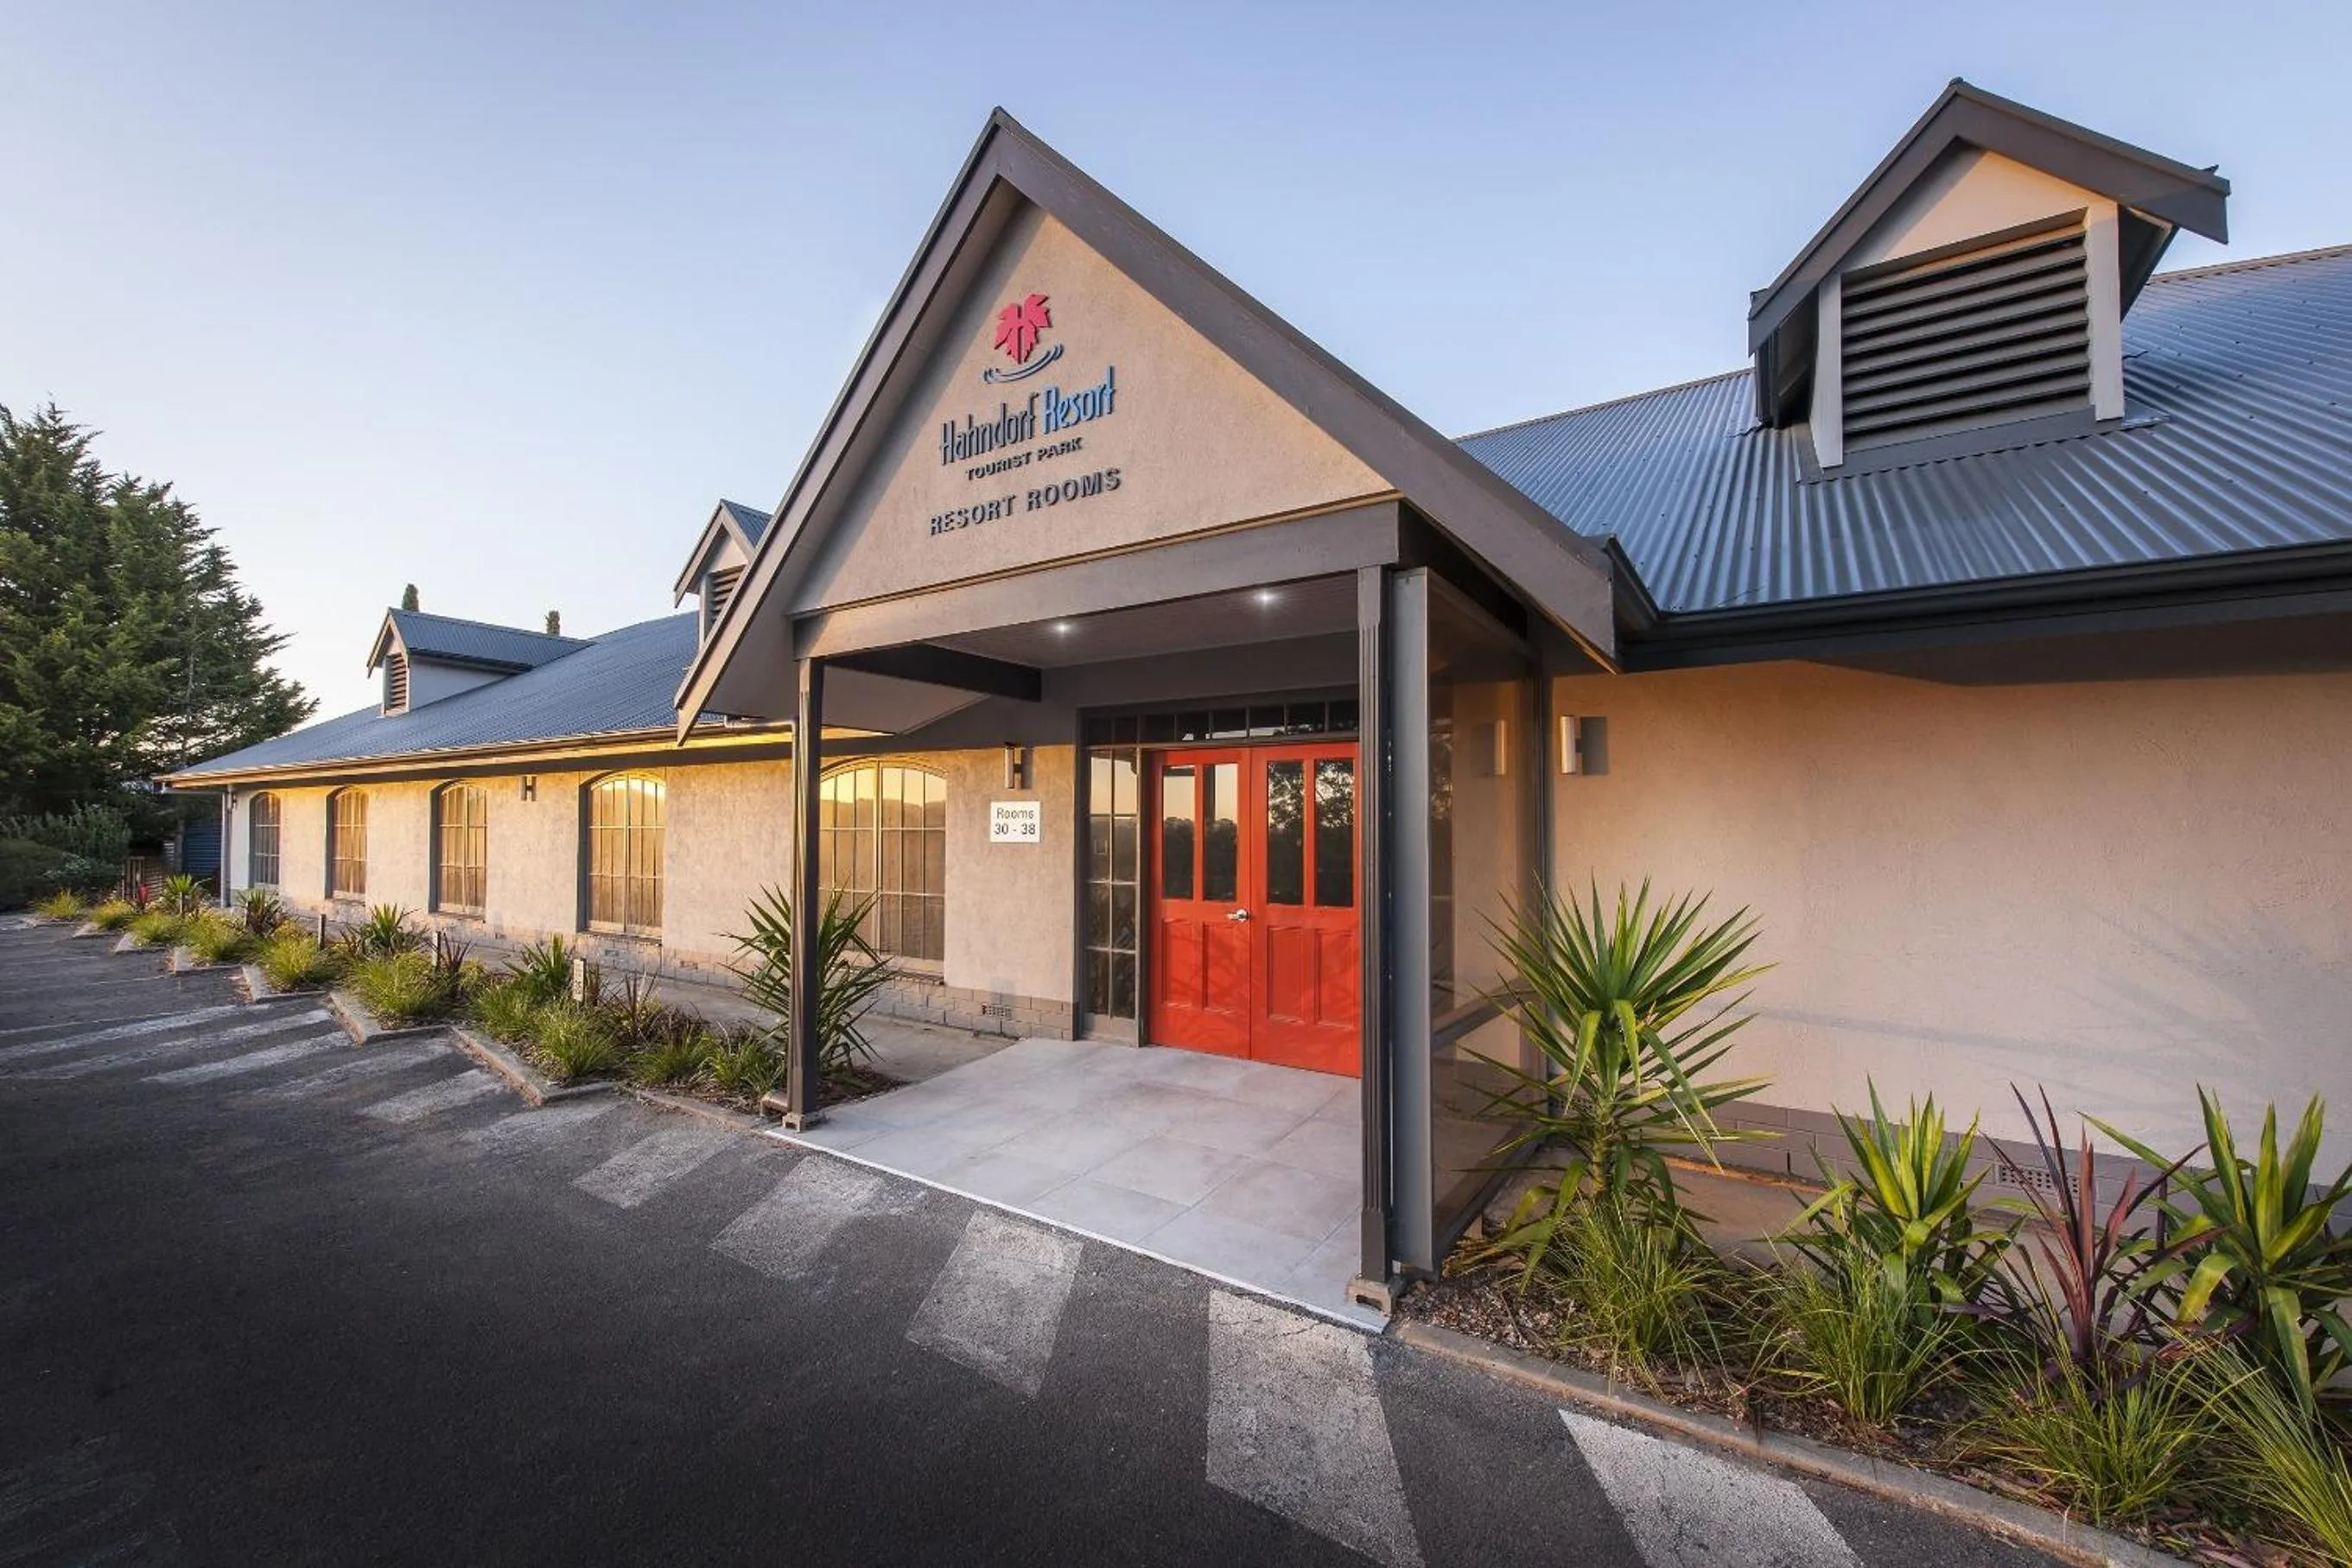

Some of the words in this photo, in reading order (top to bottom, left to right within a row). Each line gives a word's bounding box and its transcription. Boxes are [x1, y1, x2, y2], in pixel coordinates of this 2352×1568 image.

[941, 392, 1039, 466] Hahndorf
[1043, 365, 1116, 434] Resort
[966, 451, 1032, 480] TOURIST
[1037, 436, 1084, 461] PARK
[930, 494, 1016, 536] RESORT
[1027, 467, 1122, 511] ROOMS
[994, 822, 1009, 835] 30
[1021, 822, 1036, 835] 38
[996, 807, 1034, 819] Rooms
